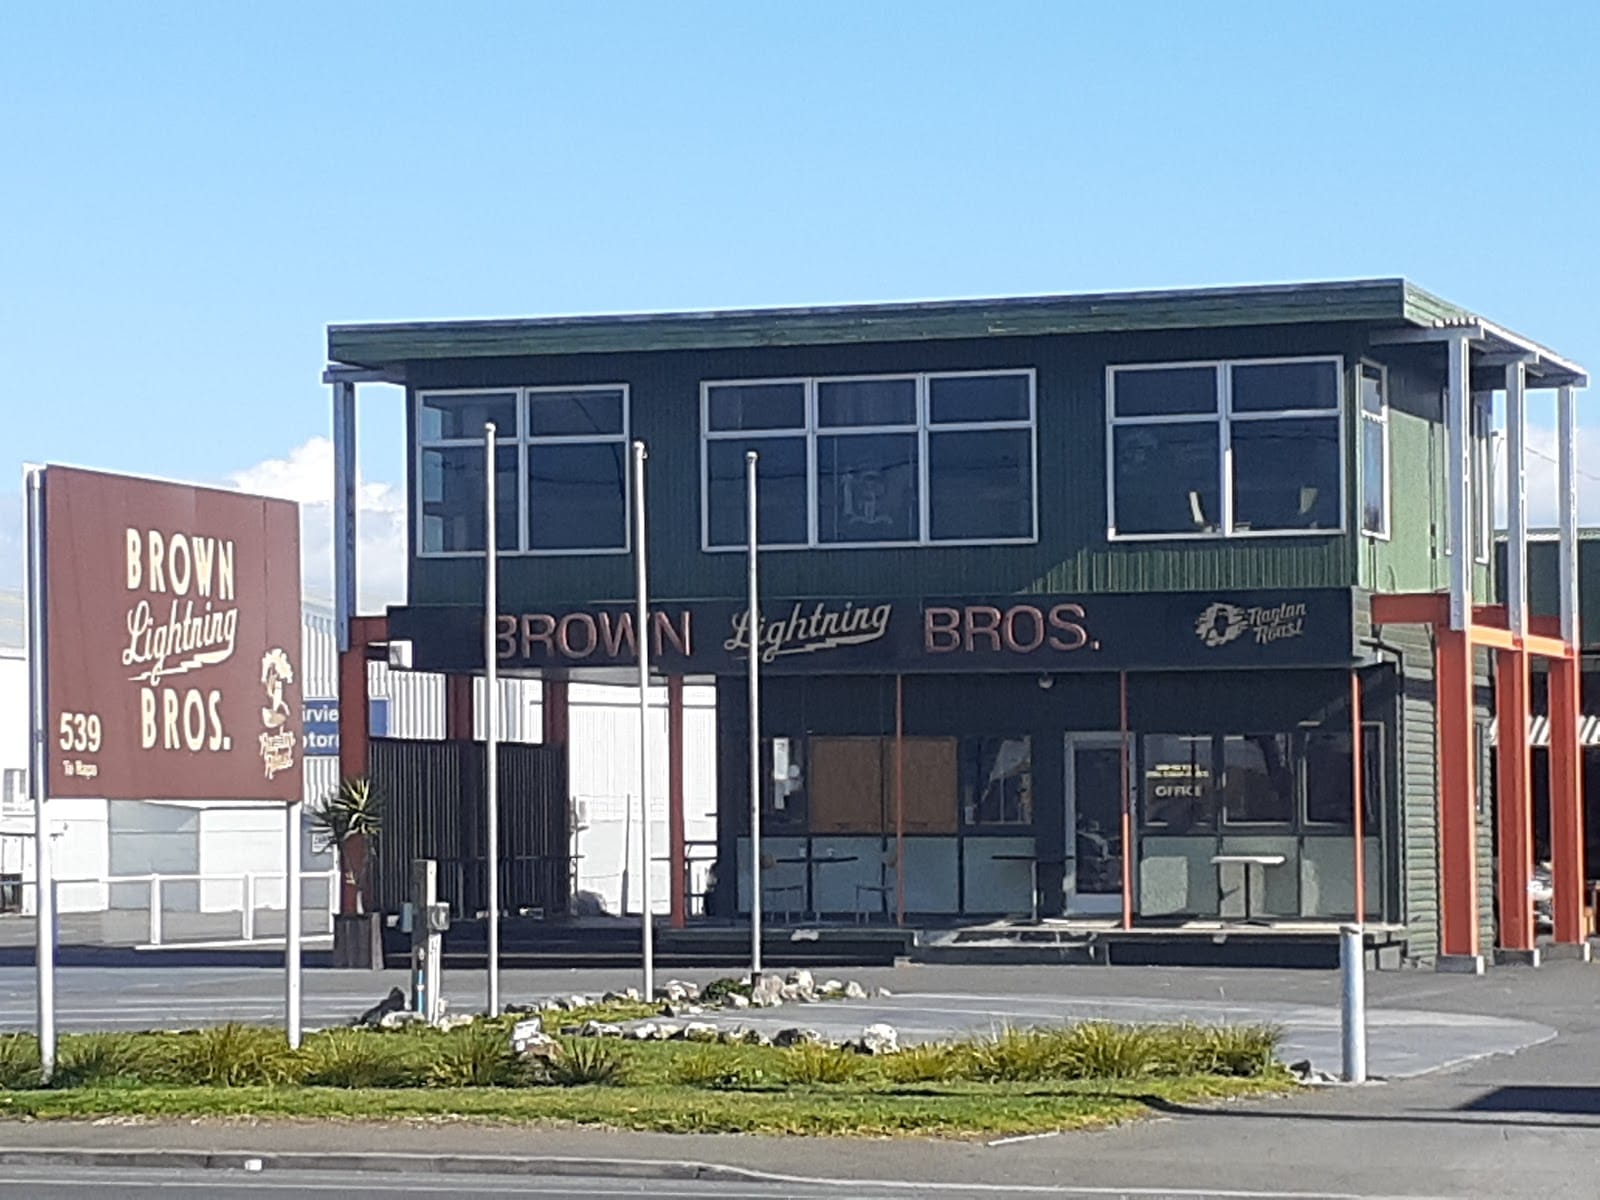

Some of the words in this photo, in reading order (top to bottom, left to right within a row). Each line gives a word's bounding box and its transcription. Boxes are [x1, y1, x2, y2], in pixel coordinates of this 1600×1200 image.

[126, 528, 234, 600] BROWN
[122, 599, 238, 686] Lightning
[485, 610, 690, 658] BROWN
[724, 602, 891, 663] Lightning
[924, 603, 1100, 653] BROS.
[60, 712, 101, 752] 539
[141, 687, 231, 751] BROS.
